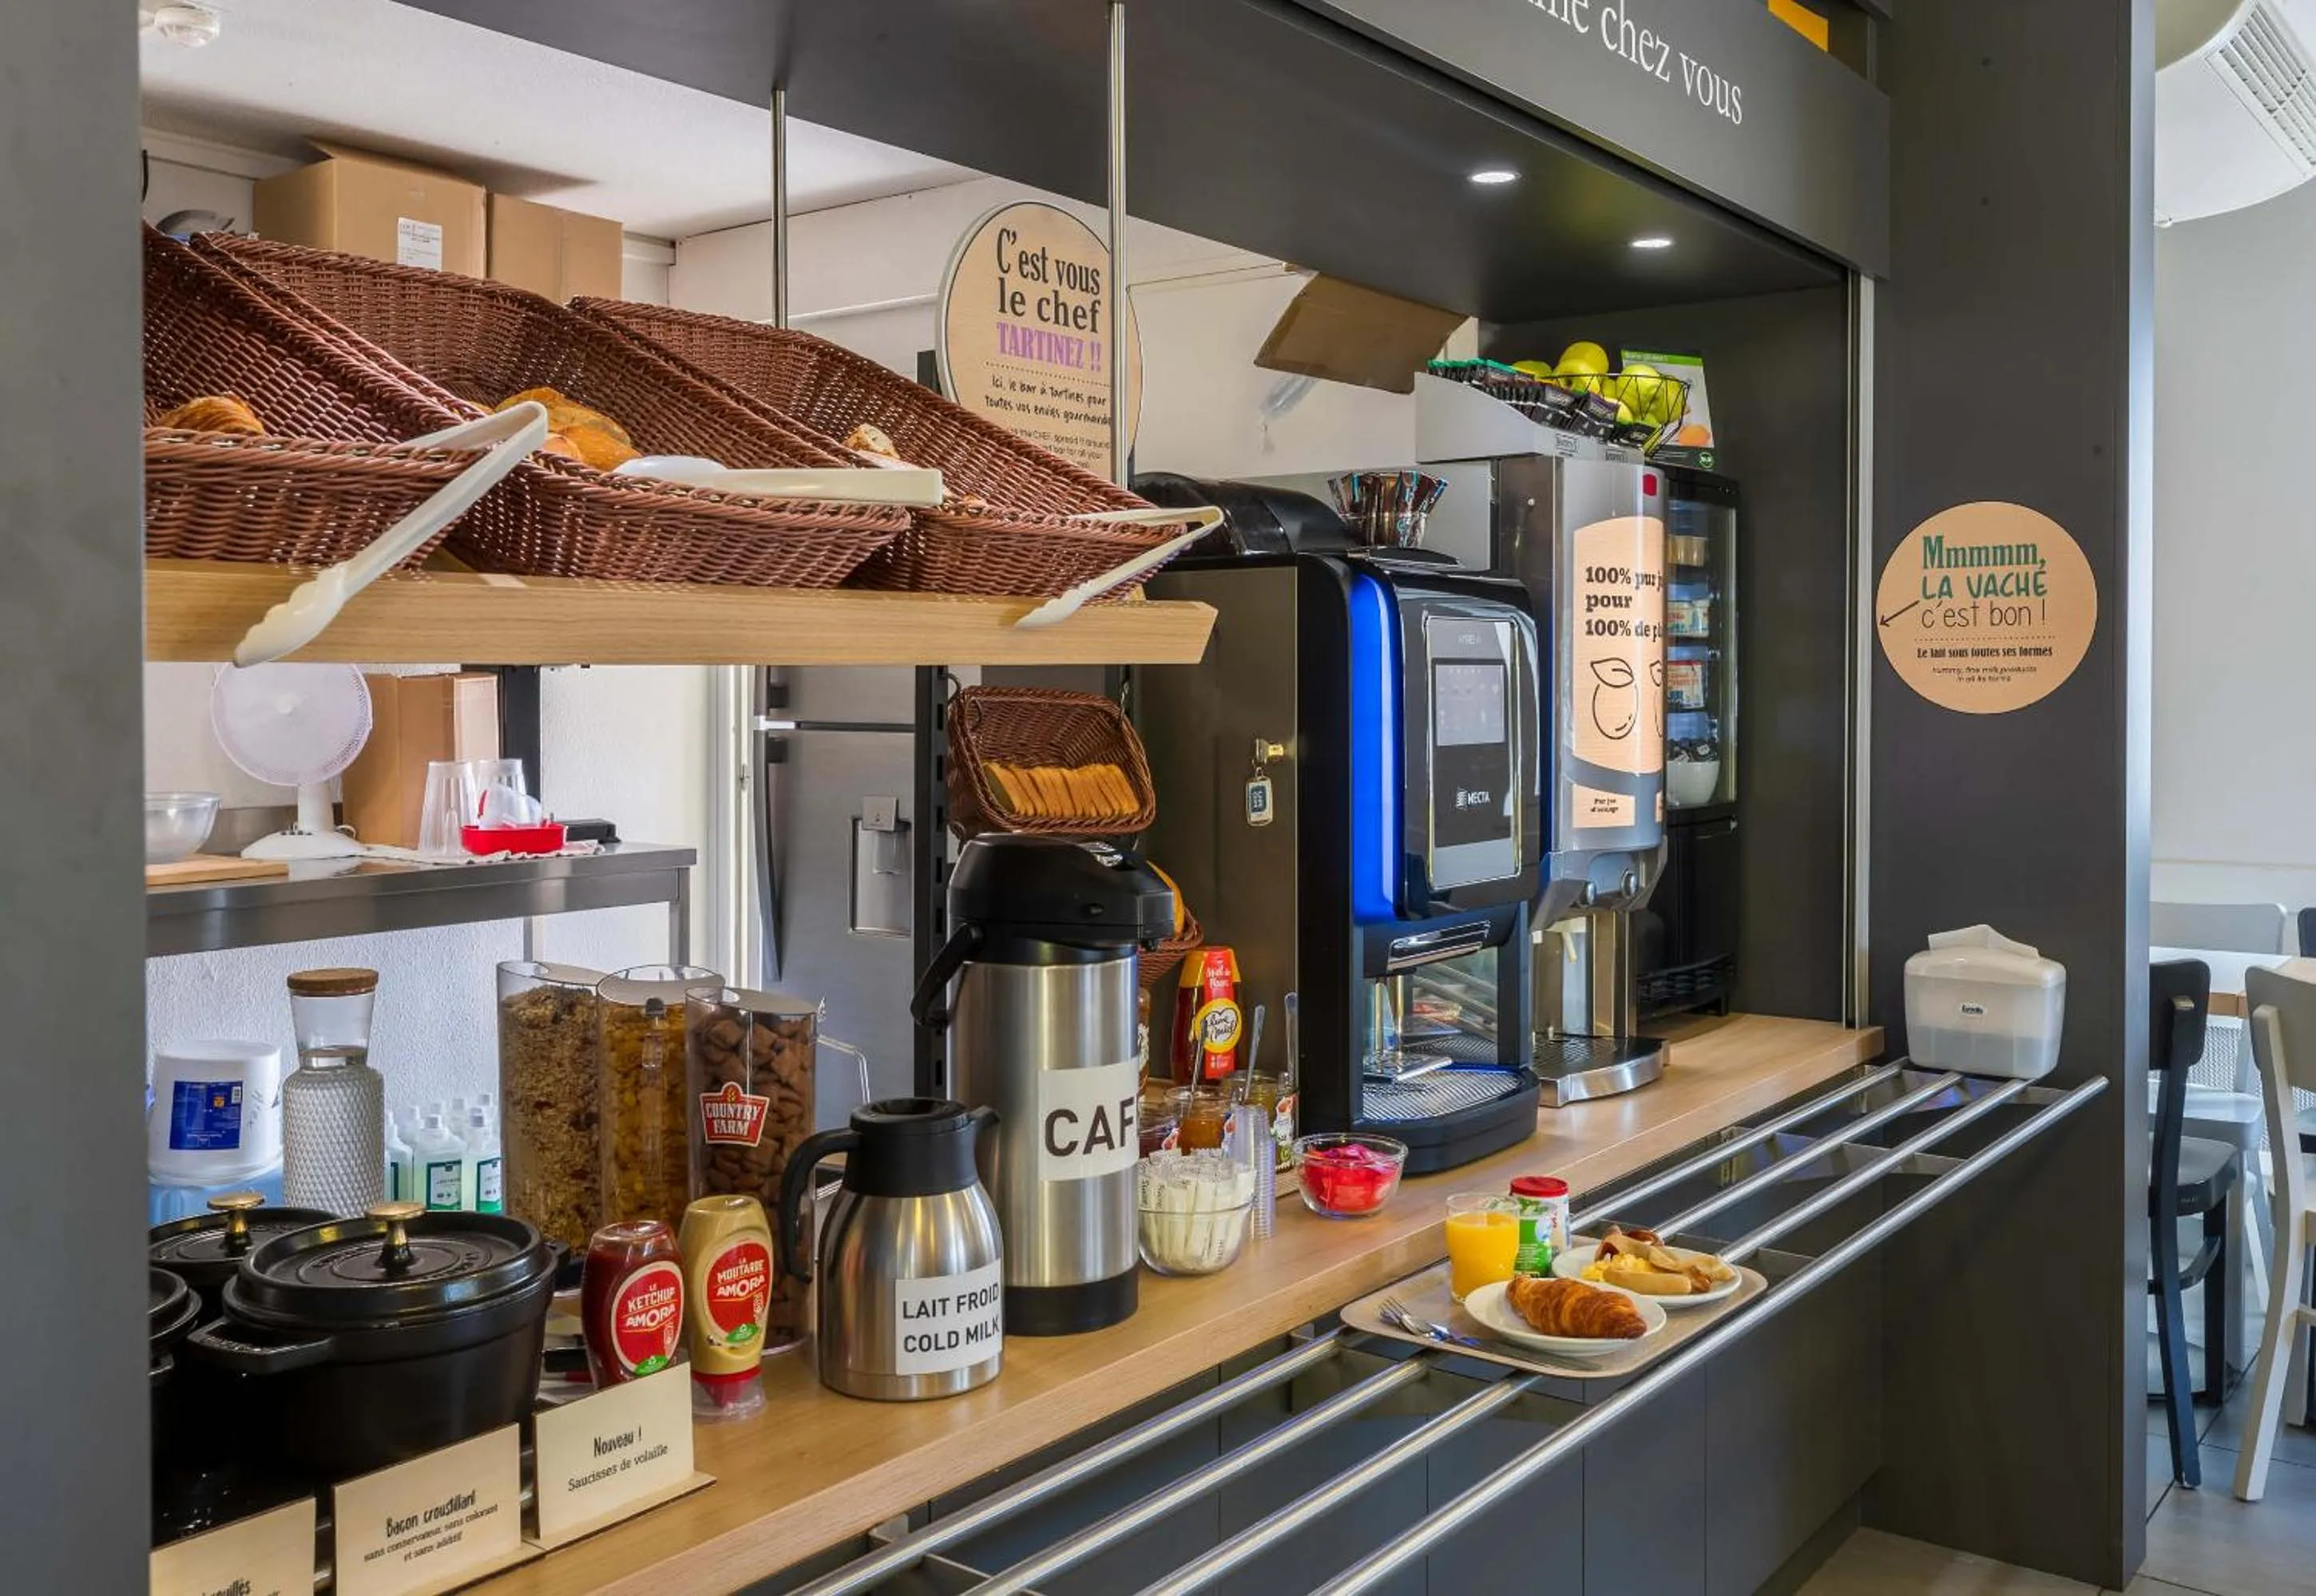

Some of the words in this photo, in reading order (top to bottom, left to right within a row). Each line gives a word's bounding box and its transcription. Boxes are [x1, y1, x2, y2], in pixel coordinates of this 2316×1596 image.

[1600, 0, 1670, 82] chez
[1679, 51, 1743, 125] vous
[997, 228, 1049, 283] C'est
[1055, 259, 1100, 296] vous
[998, 277, 1026, 317] le
[1037, 290, 1100, 334] chef
[997, 322, 1085, 370] TARTINEZ
[1090, 343, 1101, 372] !!
[1922, 534, 2046, 572] Mmmmm,
[1585, 565, 1632, 584] 100%
[1635, 572, 1656, 590] pur
[1921, 574, 1953, 600] LA
[1966, 570, 2048, 599] VACHE
[1585, 594, 1632, 612] pour
[1921, 600, 1980, 629] c'est
[1989, 600, 2031, 627] bon
[1584, 619, 1632, 636] 100%
[1635, 620, 1652, 637] de
[1948, 648, 1969, 658] sous
[1971, 647, 2000, 658] toutes
[2001, 647, 2017, 657] ses
[2019, 646, 2052, 657] formes
[1467, 791, 1491, 805] NECTA
[704, 1102, 761, 1121] COUNTRY
[713, 1119, 749, 1136] FARM
[1045, 1096, 1135, 1157] CAF
[716, 1259, 764, 1282] MOUTARDE
[716, 1275, 765, 1297] AMORA
[627, 1287, 675, 1312] KETCHUP
[902, 1297, 950, 1320] LAIT
[956, 1282, 999, 1313] FROID
[625, 1304, 676, 1328] AMORA
[903, 1330, 959, 1352] COLD
[966, 1315, 1000, 1345] MILK
[593, 1432, 634, 1458] Nouveau
[568, 1464, 617, 1491] Saucisses
[620, 1458, 632, 1471] de
[386, 1515, 418, 1538] Bacon
